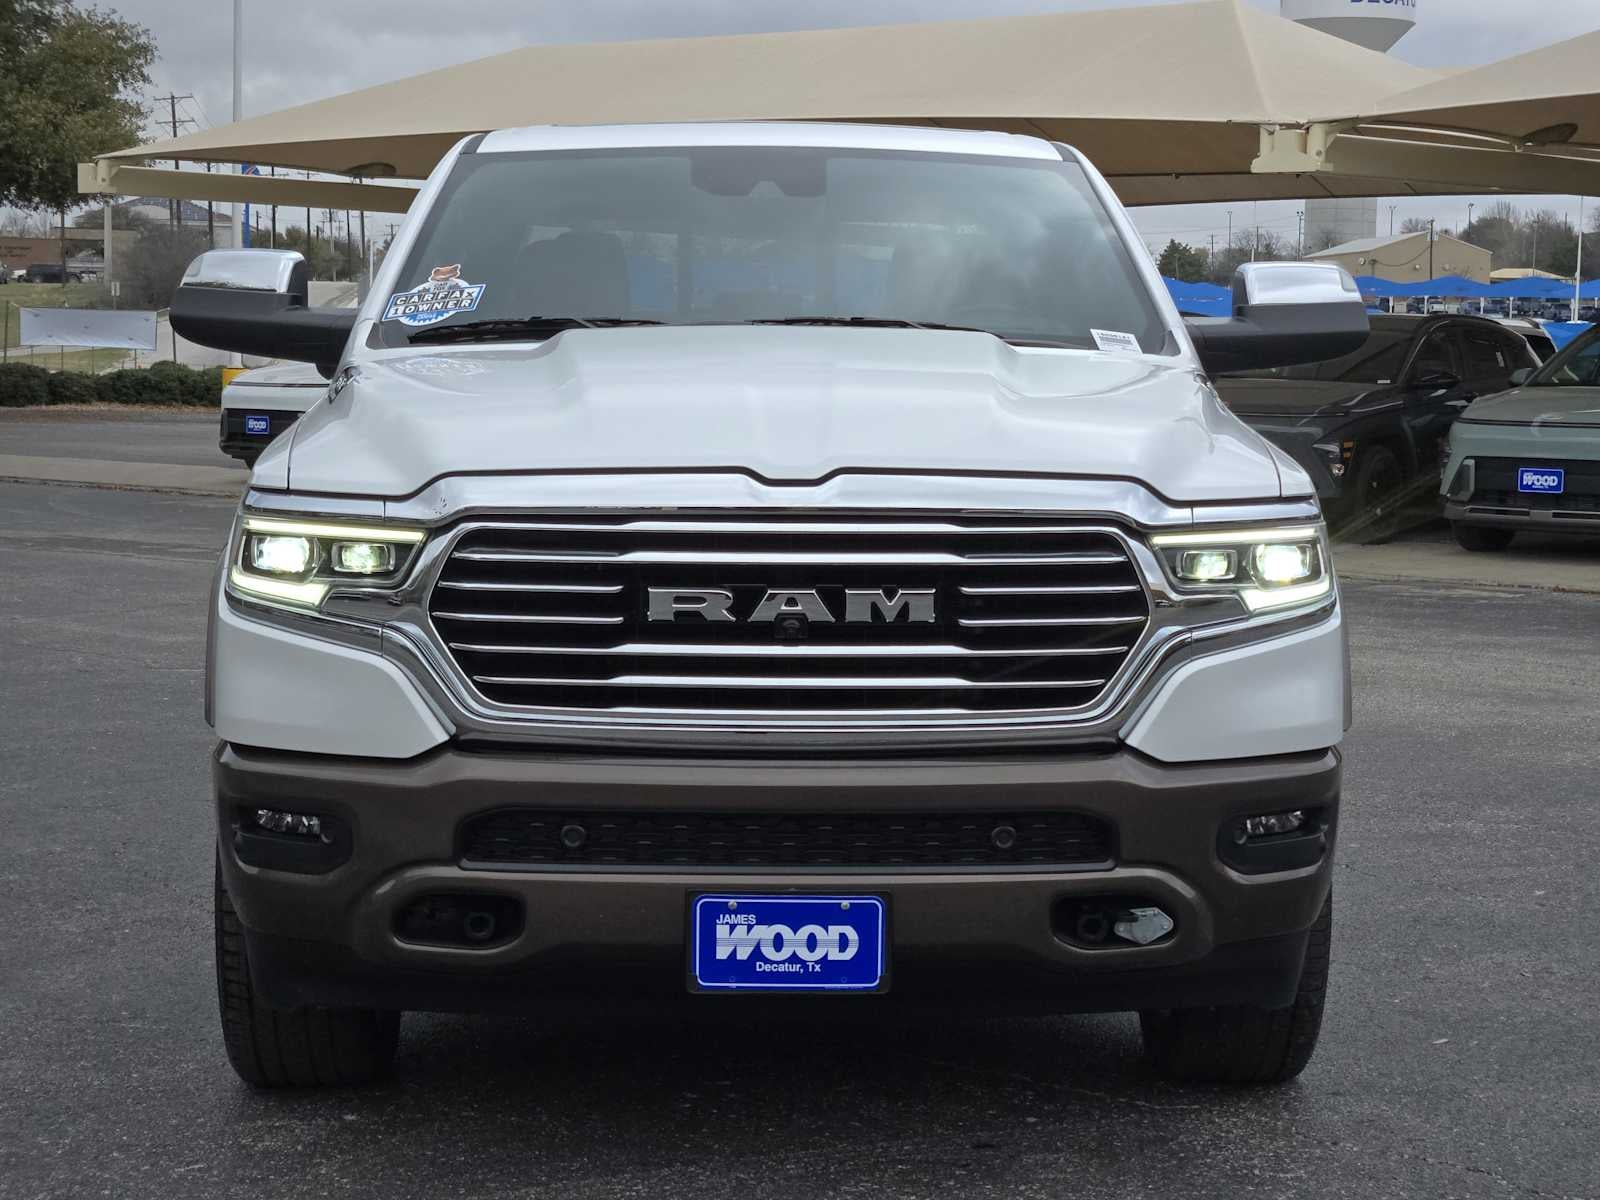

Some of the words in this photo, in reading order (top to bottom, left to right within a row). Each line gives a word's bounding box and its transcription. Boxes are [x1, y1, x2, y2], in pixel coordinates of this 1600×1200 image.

[396, 290, 475, 305] CARFAX
[405, 299, 472, 313] OWNER
[1523, 474, 1558, 486] WOOD
[648, 587, 936, 622] RAM
[716, 914, 756, 925] JAMES
[716, 924, 859, 961] WOOD
[756, 962, 804, 973] Decatur,
[806, 962, 821, 972] Tx
